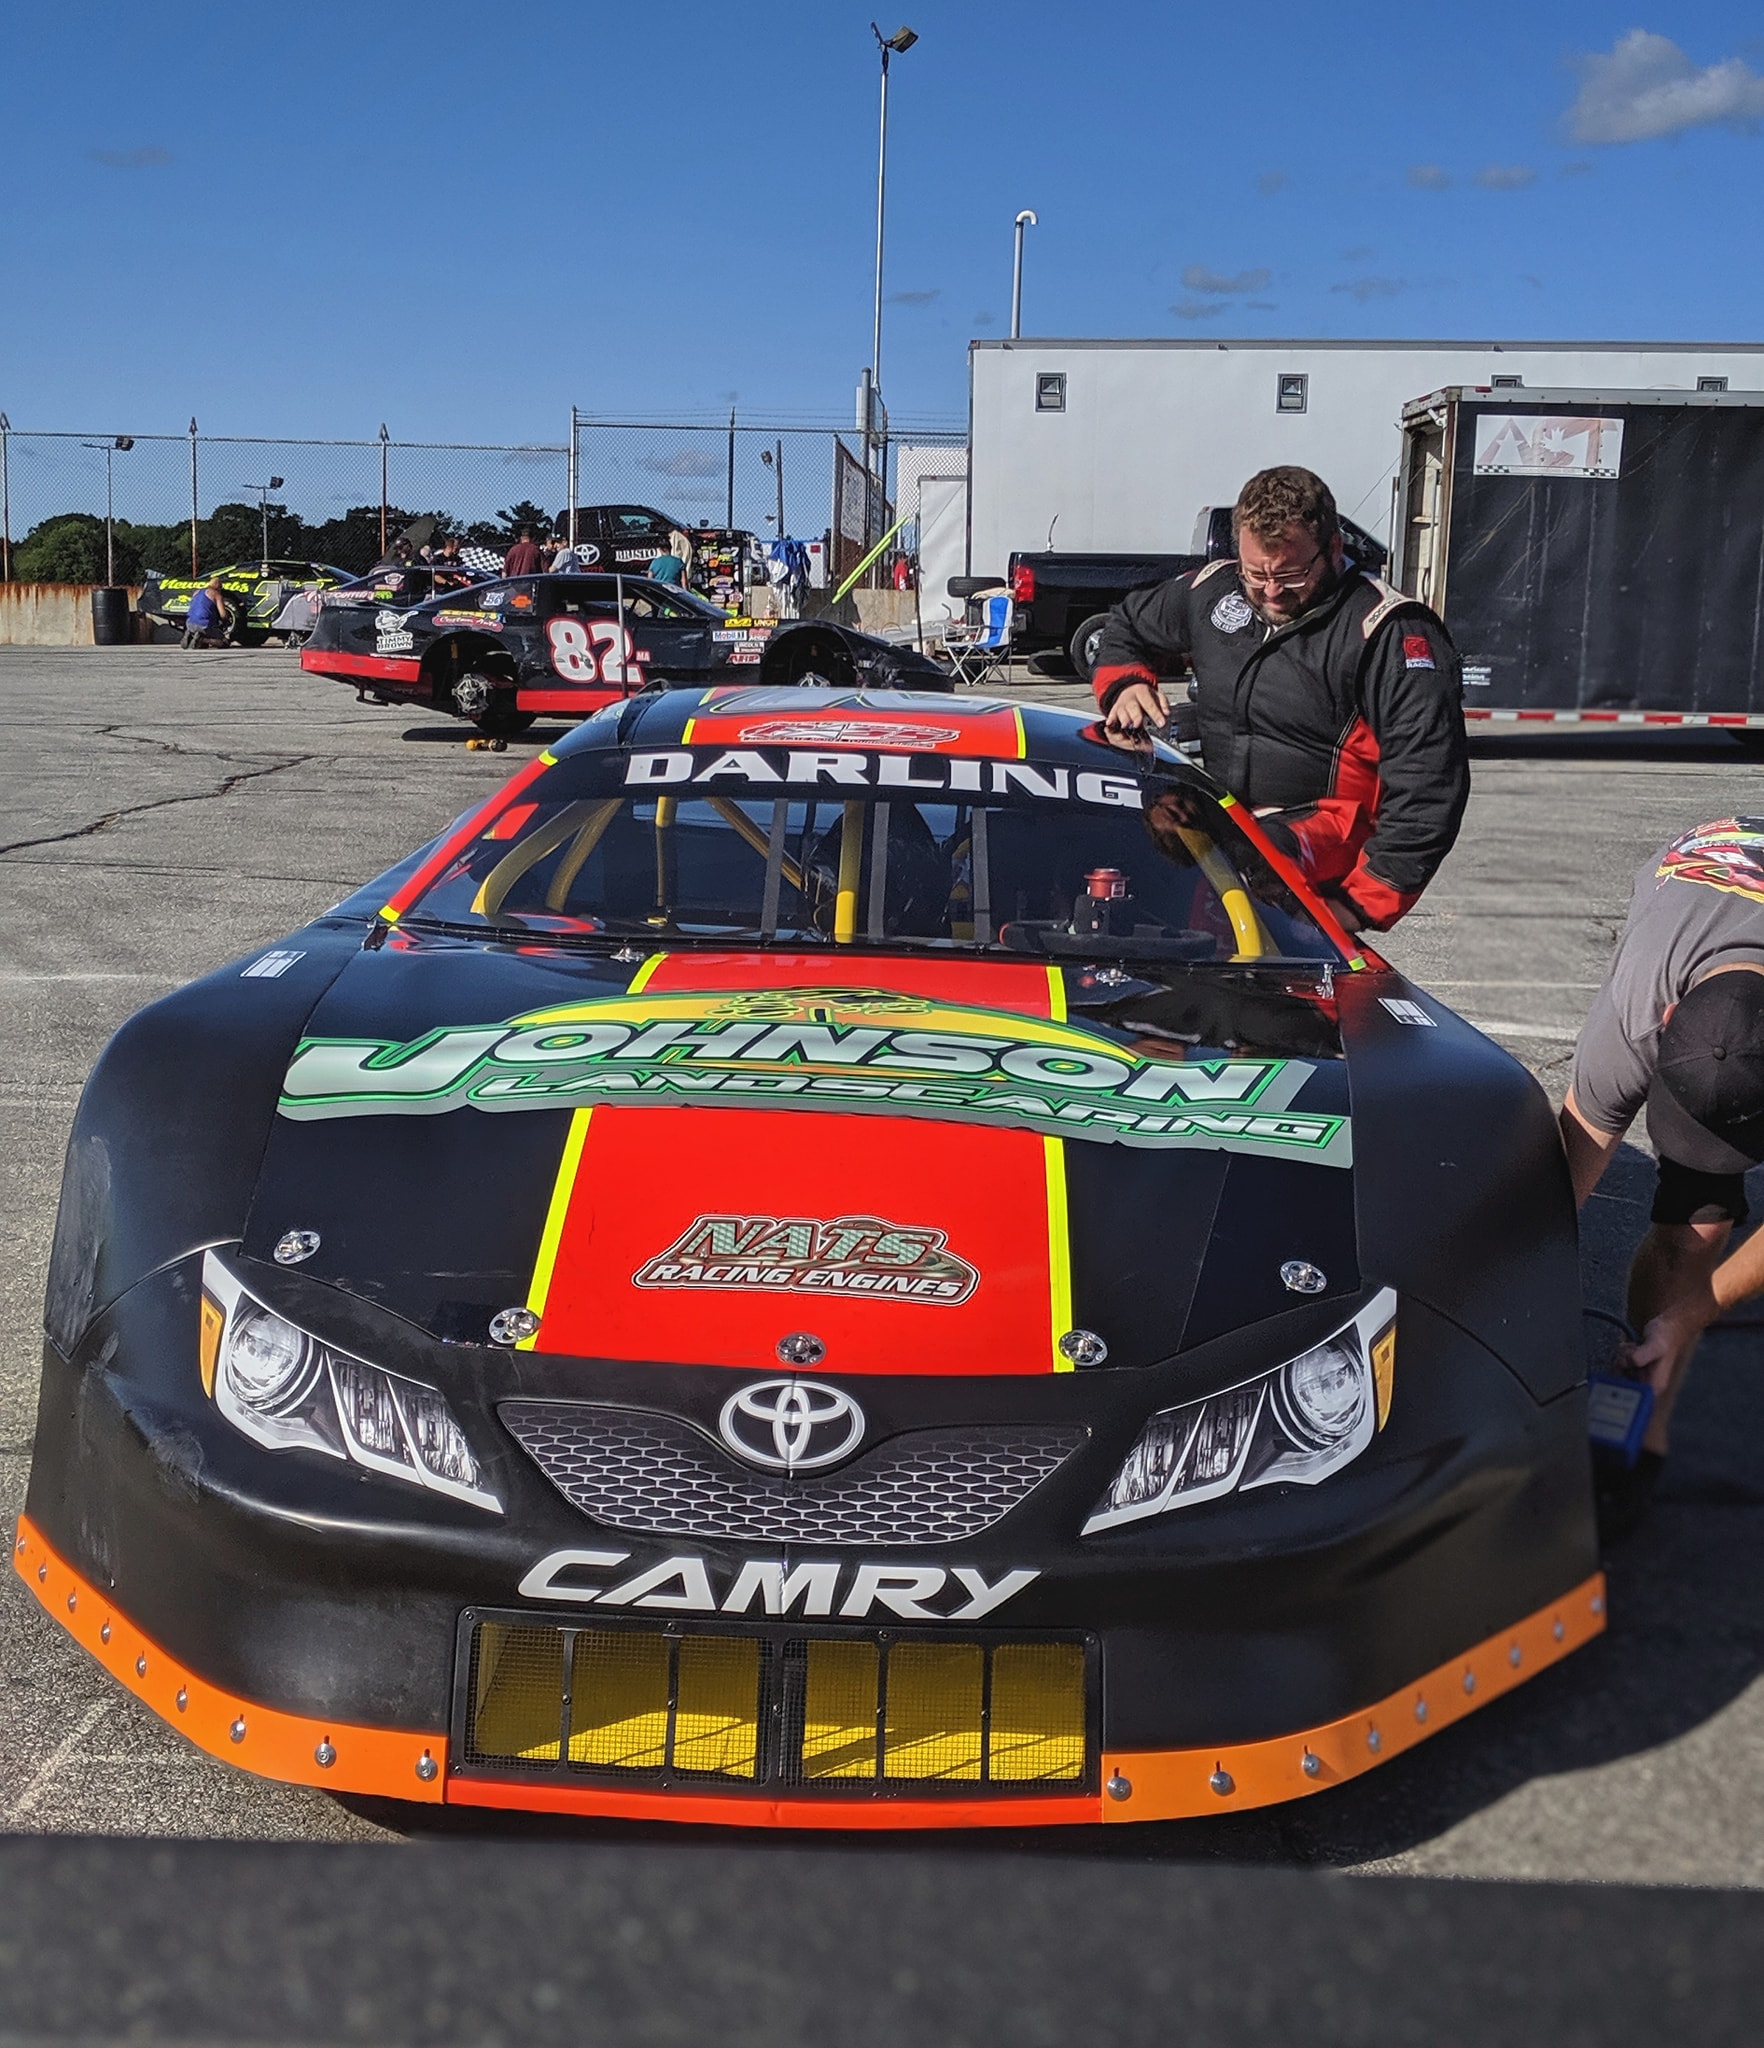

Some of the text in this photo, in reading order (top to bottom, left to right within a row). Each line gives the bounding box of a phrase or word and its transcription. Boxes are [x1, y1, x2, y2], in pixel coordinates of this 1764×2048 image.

[1477, 417, 1618, 467] ACT
[377, 641, 412, 650] BROWN
[379, 635, 411, 644] TIMMY
[545, 617, 645, 685] 82
[635, 650, 650, 662] MA
[714, 631, 736, 640] Mobil
[624, 750, 1143, 809] DARLING
[281, 1019, 1284, 1104] JOHNSON
[473, 1070, 1338, 1144] LANDSCAPING
[680, 1221, 934, 1266] NATS
[647, 1264, 964, 1298] RACING ENGINES
[517, 1549, 1042, 1620] CAMRY
